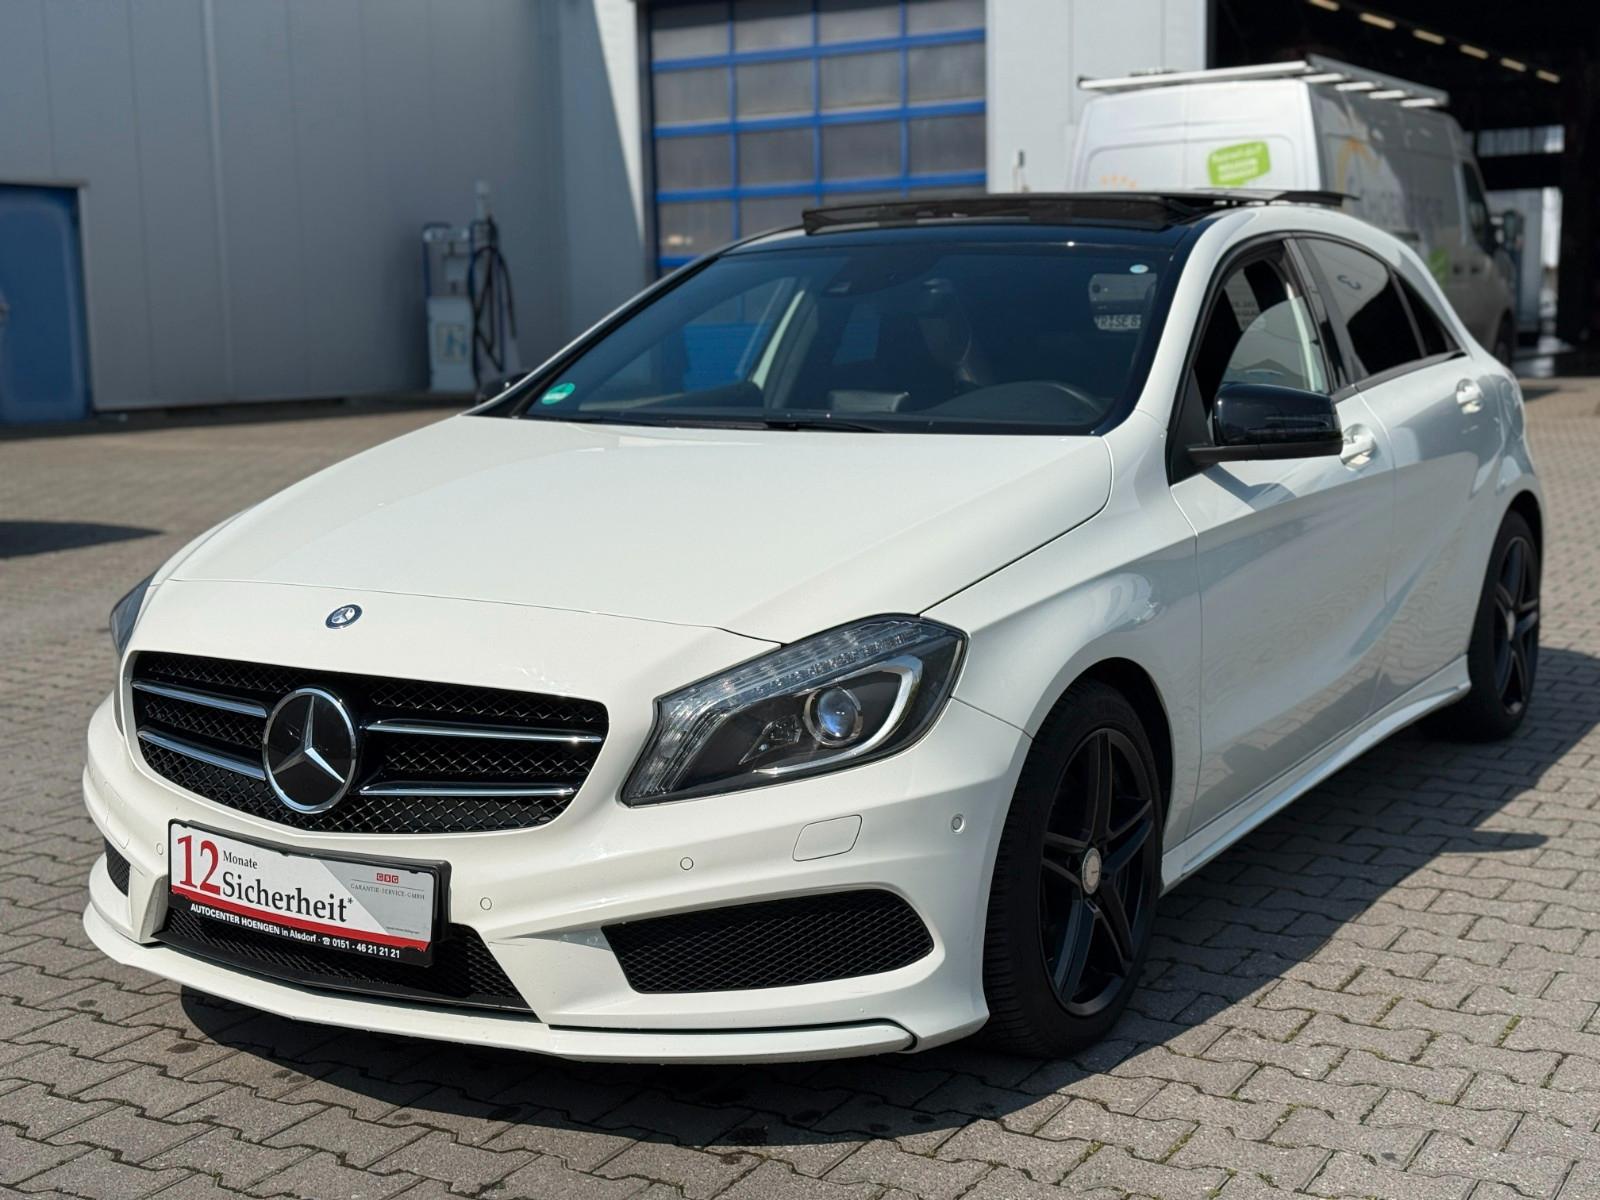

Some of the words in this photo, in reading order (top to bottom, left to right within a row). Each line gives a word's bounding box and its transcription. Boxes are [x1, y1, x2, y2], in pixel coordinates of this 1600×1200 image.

[177, 835, 220, 895] 12
[223, 850, 258, 869] Monate
[190, 903, 240, 925] AUTOCENTER
[241, 917, 280, 935] HOENGEN
[281, 927, 289, 937] in
[289, 929, 317, 944] Alsdorf
[332, 938, 350, 950] 0151
[356, 943, 366, 953] 46
[367, 944, 377, 955] 21
[378, 946, 389, 957] 21
[389, 948, 400, 958] 21
